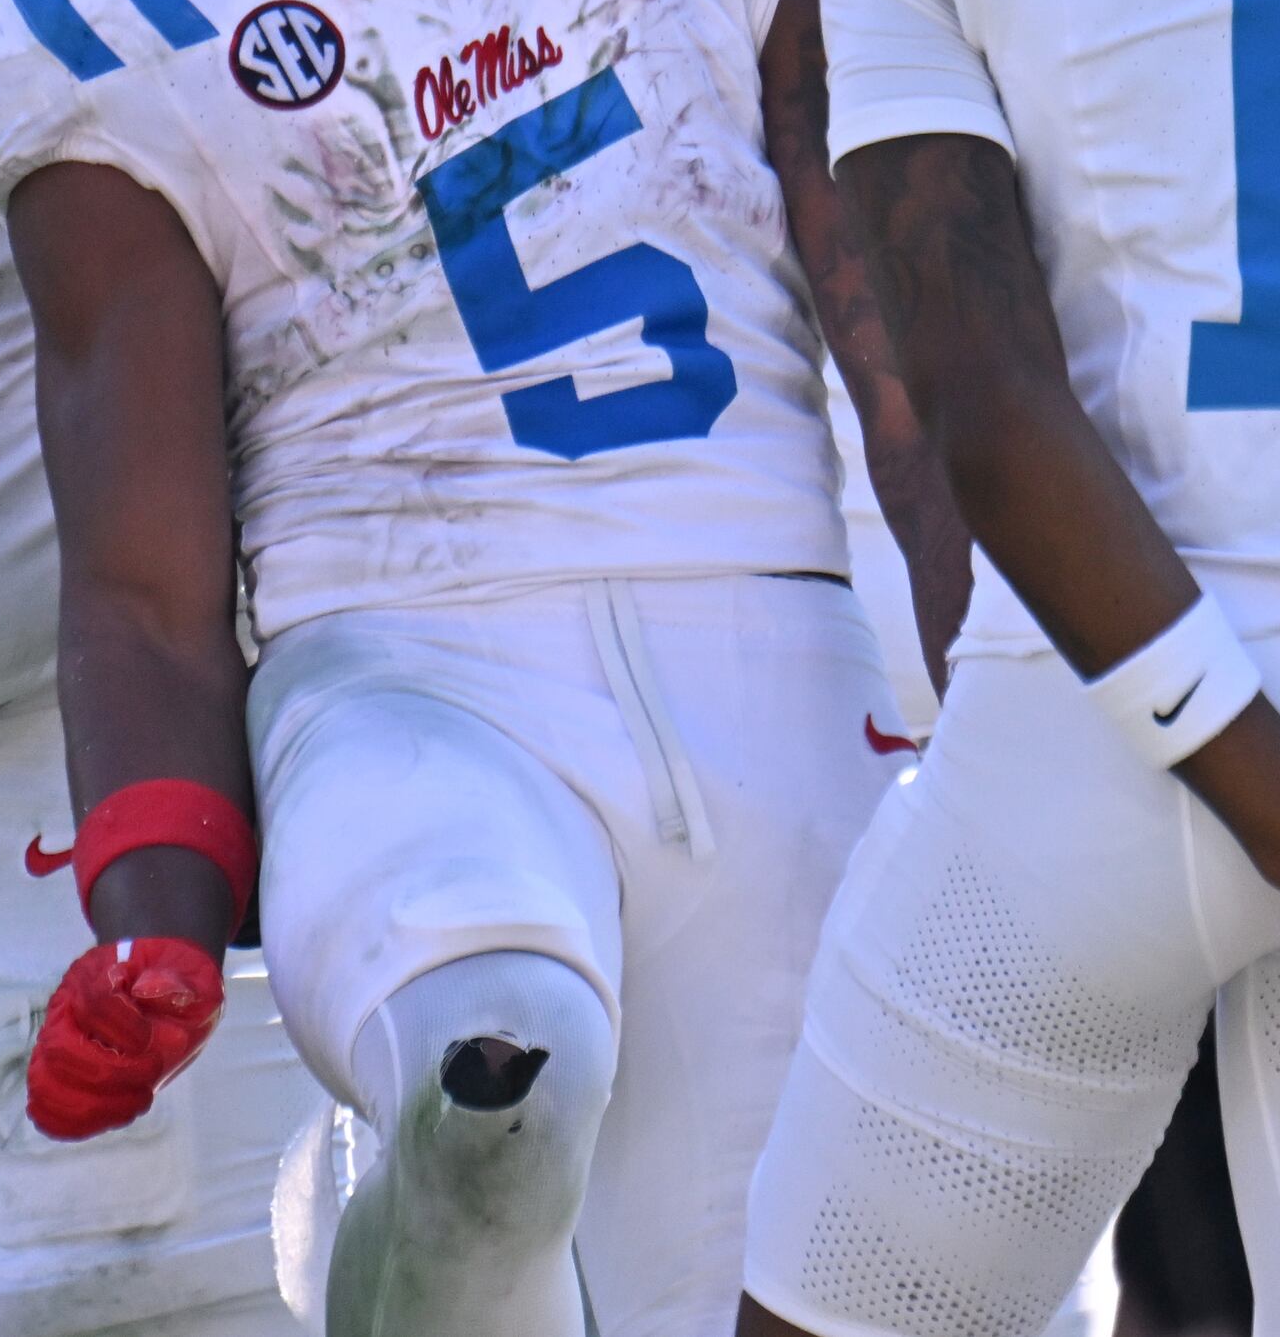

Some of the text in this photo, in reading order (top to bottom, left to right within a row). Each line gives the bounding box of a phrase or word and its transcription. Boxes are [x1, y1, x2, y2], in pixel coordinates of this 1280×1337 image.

[238, 6, 336, 105] SEC
[414, 24, 564, 141] Ole Miss
[414, 65, 738, 462] 5
